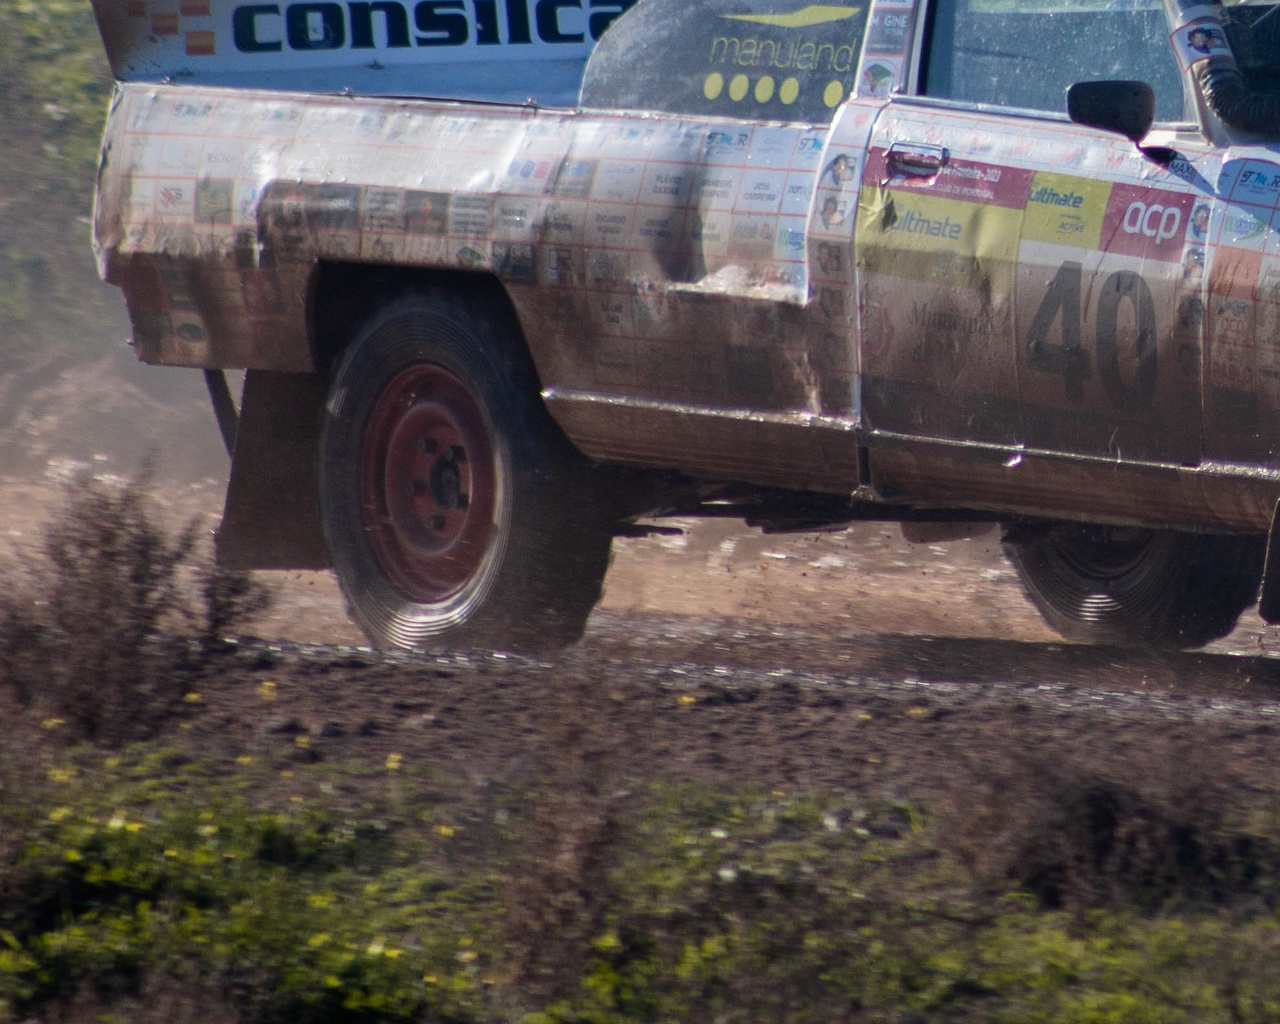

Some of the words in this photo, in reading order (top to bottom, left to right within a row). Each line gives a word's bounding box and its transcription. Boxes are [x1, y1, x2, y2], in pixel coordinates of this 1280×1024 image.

[708, 34, 857, 73] manuland
[1028, 186, 1084, 209] ultimate
[889, 209, 963, 240] ultimate
[1122, 200, 1182, 245] acp
[1025, 260, 1158, 410] 40
